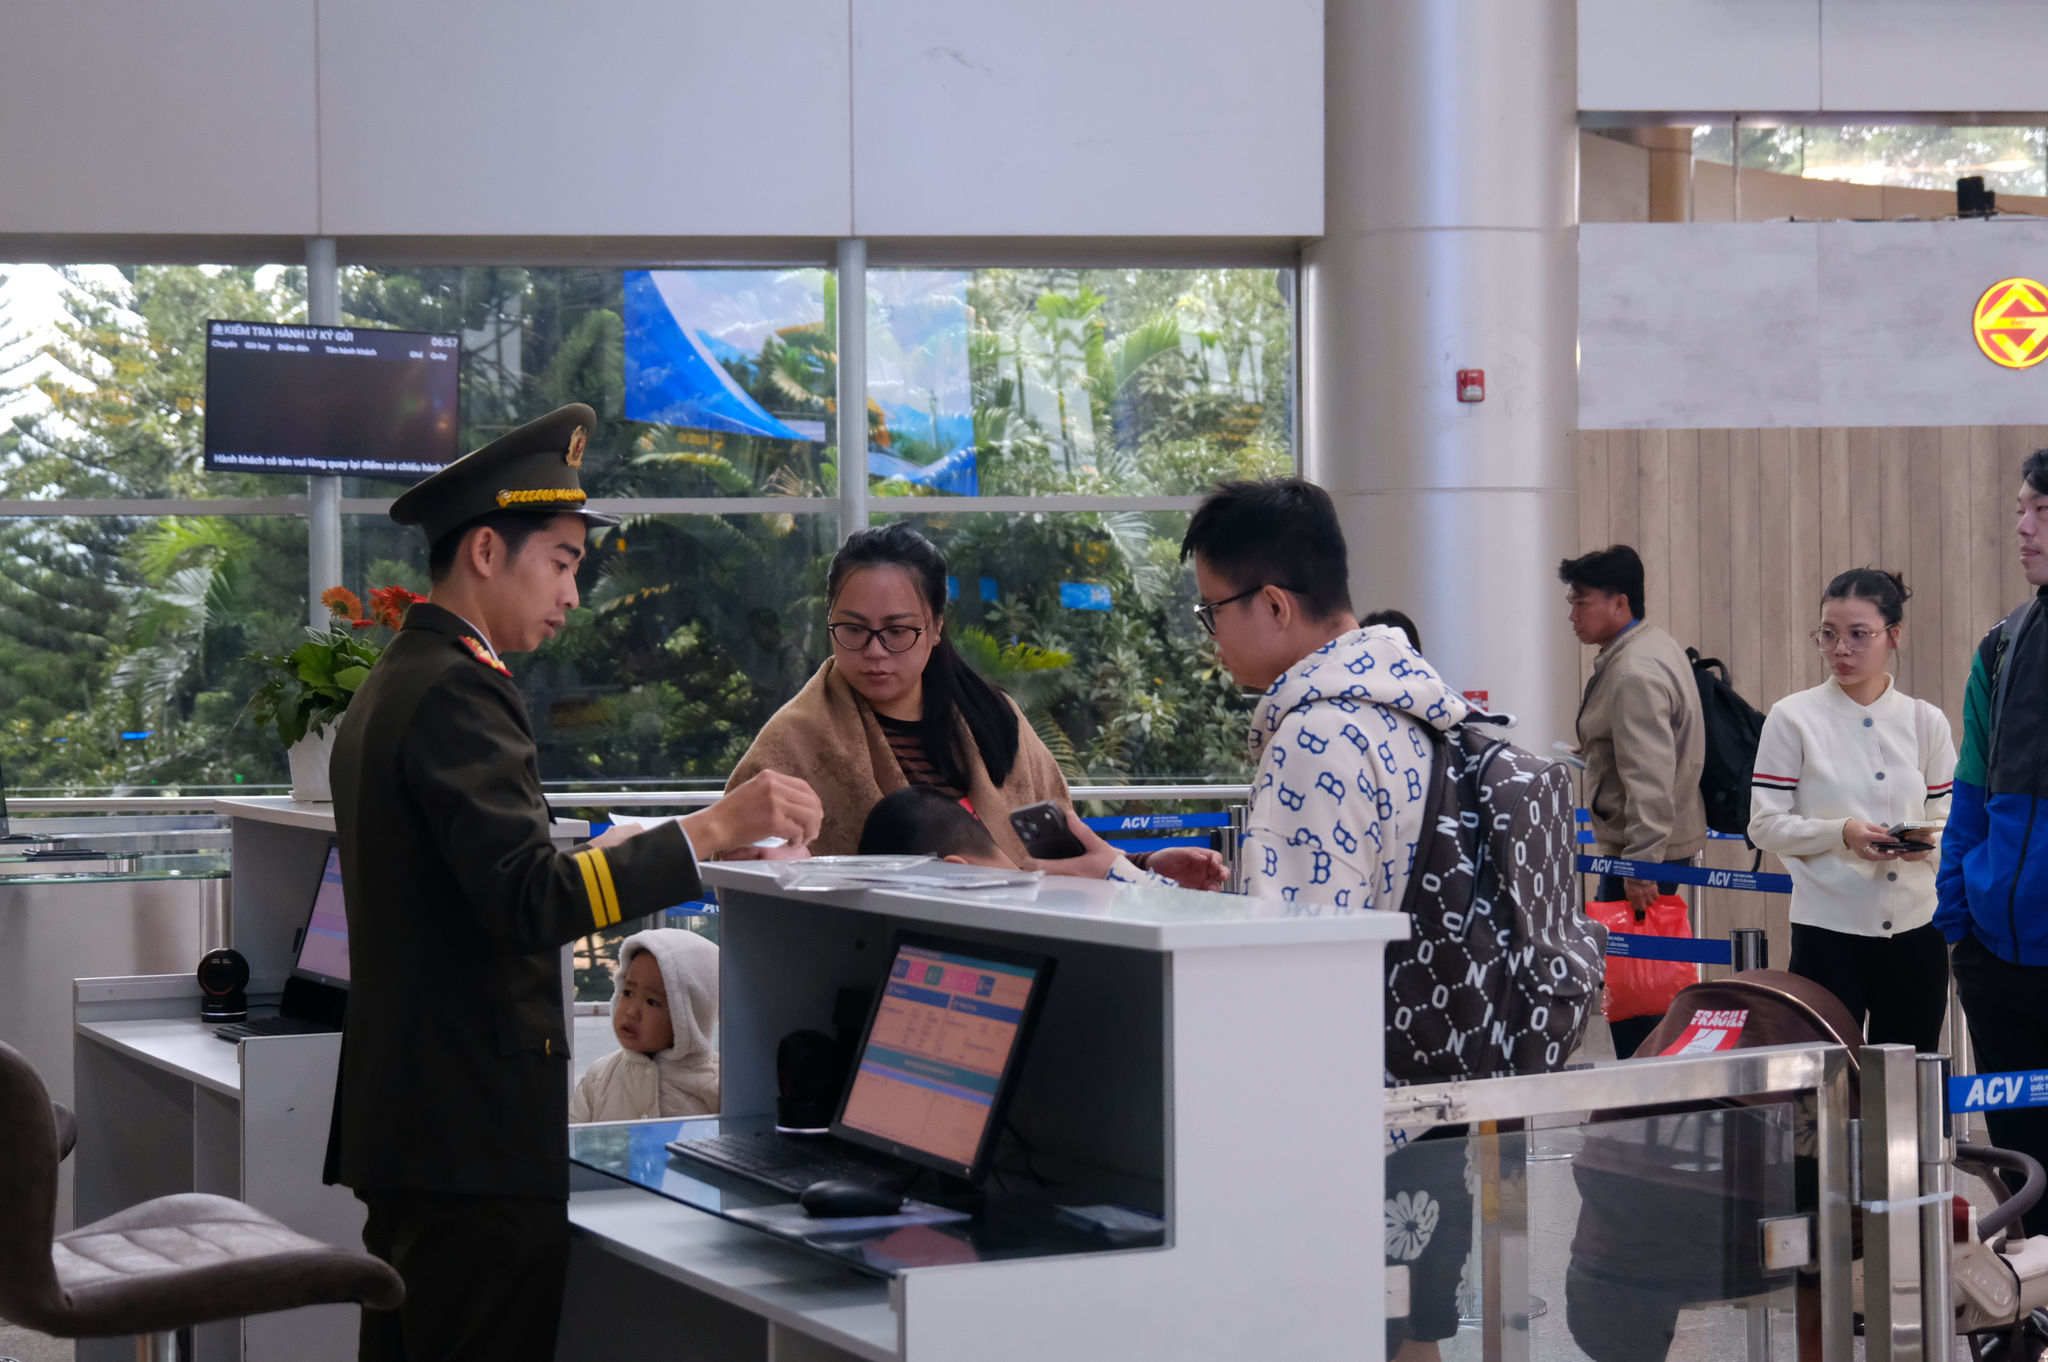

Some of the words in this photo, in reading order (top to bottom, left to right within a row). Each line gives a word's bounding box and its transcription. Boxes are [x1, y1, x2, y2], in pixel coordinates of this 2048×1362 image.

[252, 326, 273, 337] TRA
[274, 326, 305, 339] HÀNH
[431, 336, 458, 347] 06:57
[1121, 817, 1150, 829] ACV
[1590, 858, 1612, 874] ACV
[1708, 870, 1731, 887] ACV
[1690, 1010, 1749, 1027] FRAGILE
[1965, 1076, 2024, 1108] ACV
